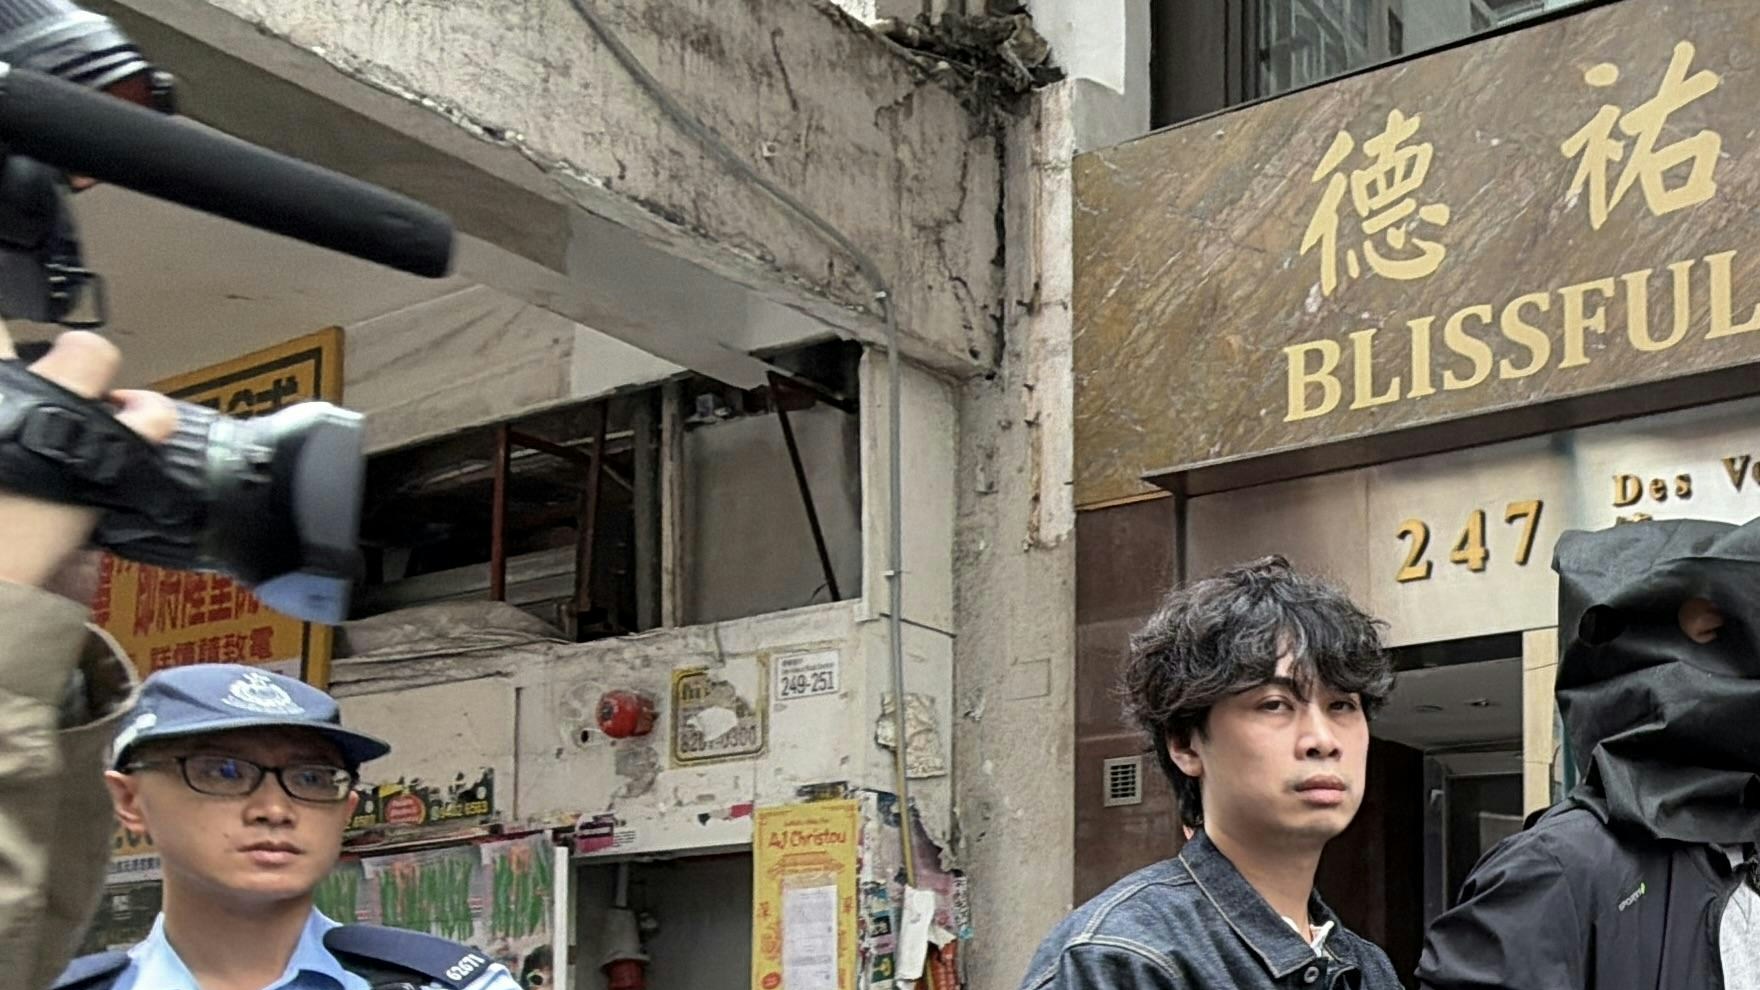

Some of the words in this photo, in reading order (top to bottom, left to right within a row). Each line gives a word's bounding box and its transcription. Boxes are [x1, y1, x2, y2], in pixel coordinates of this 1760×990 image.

[1612, 472, 1692, 508] Des
[1397, 499, 1543, 583] 247
[781, 671, 834, 696] 249-251
[446, 953, 486, 981] 62671
